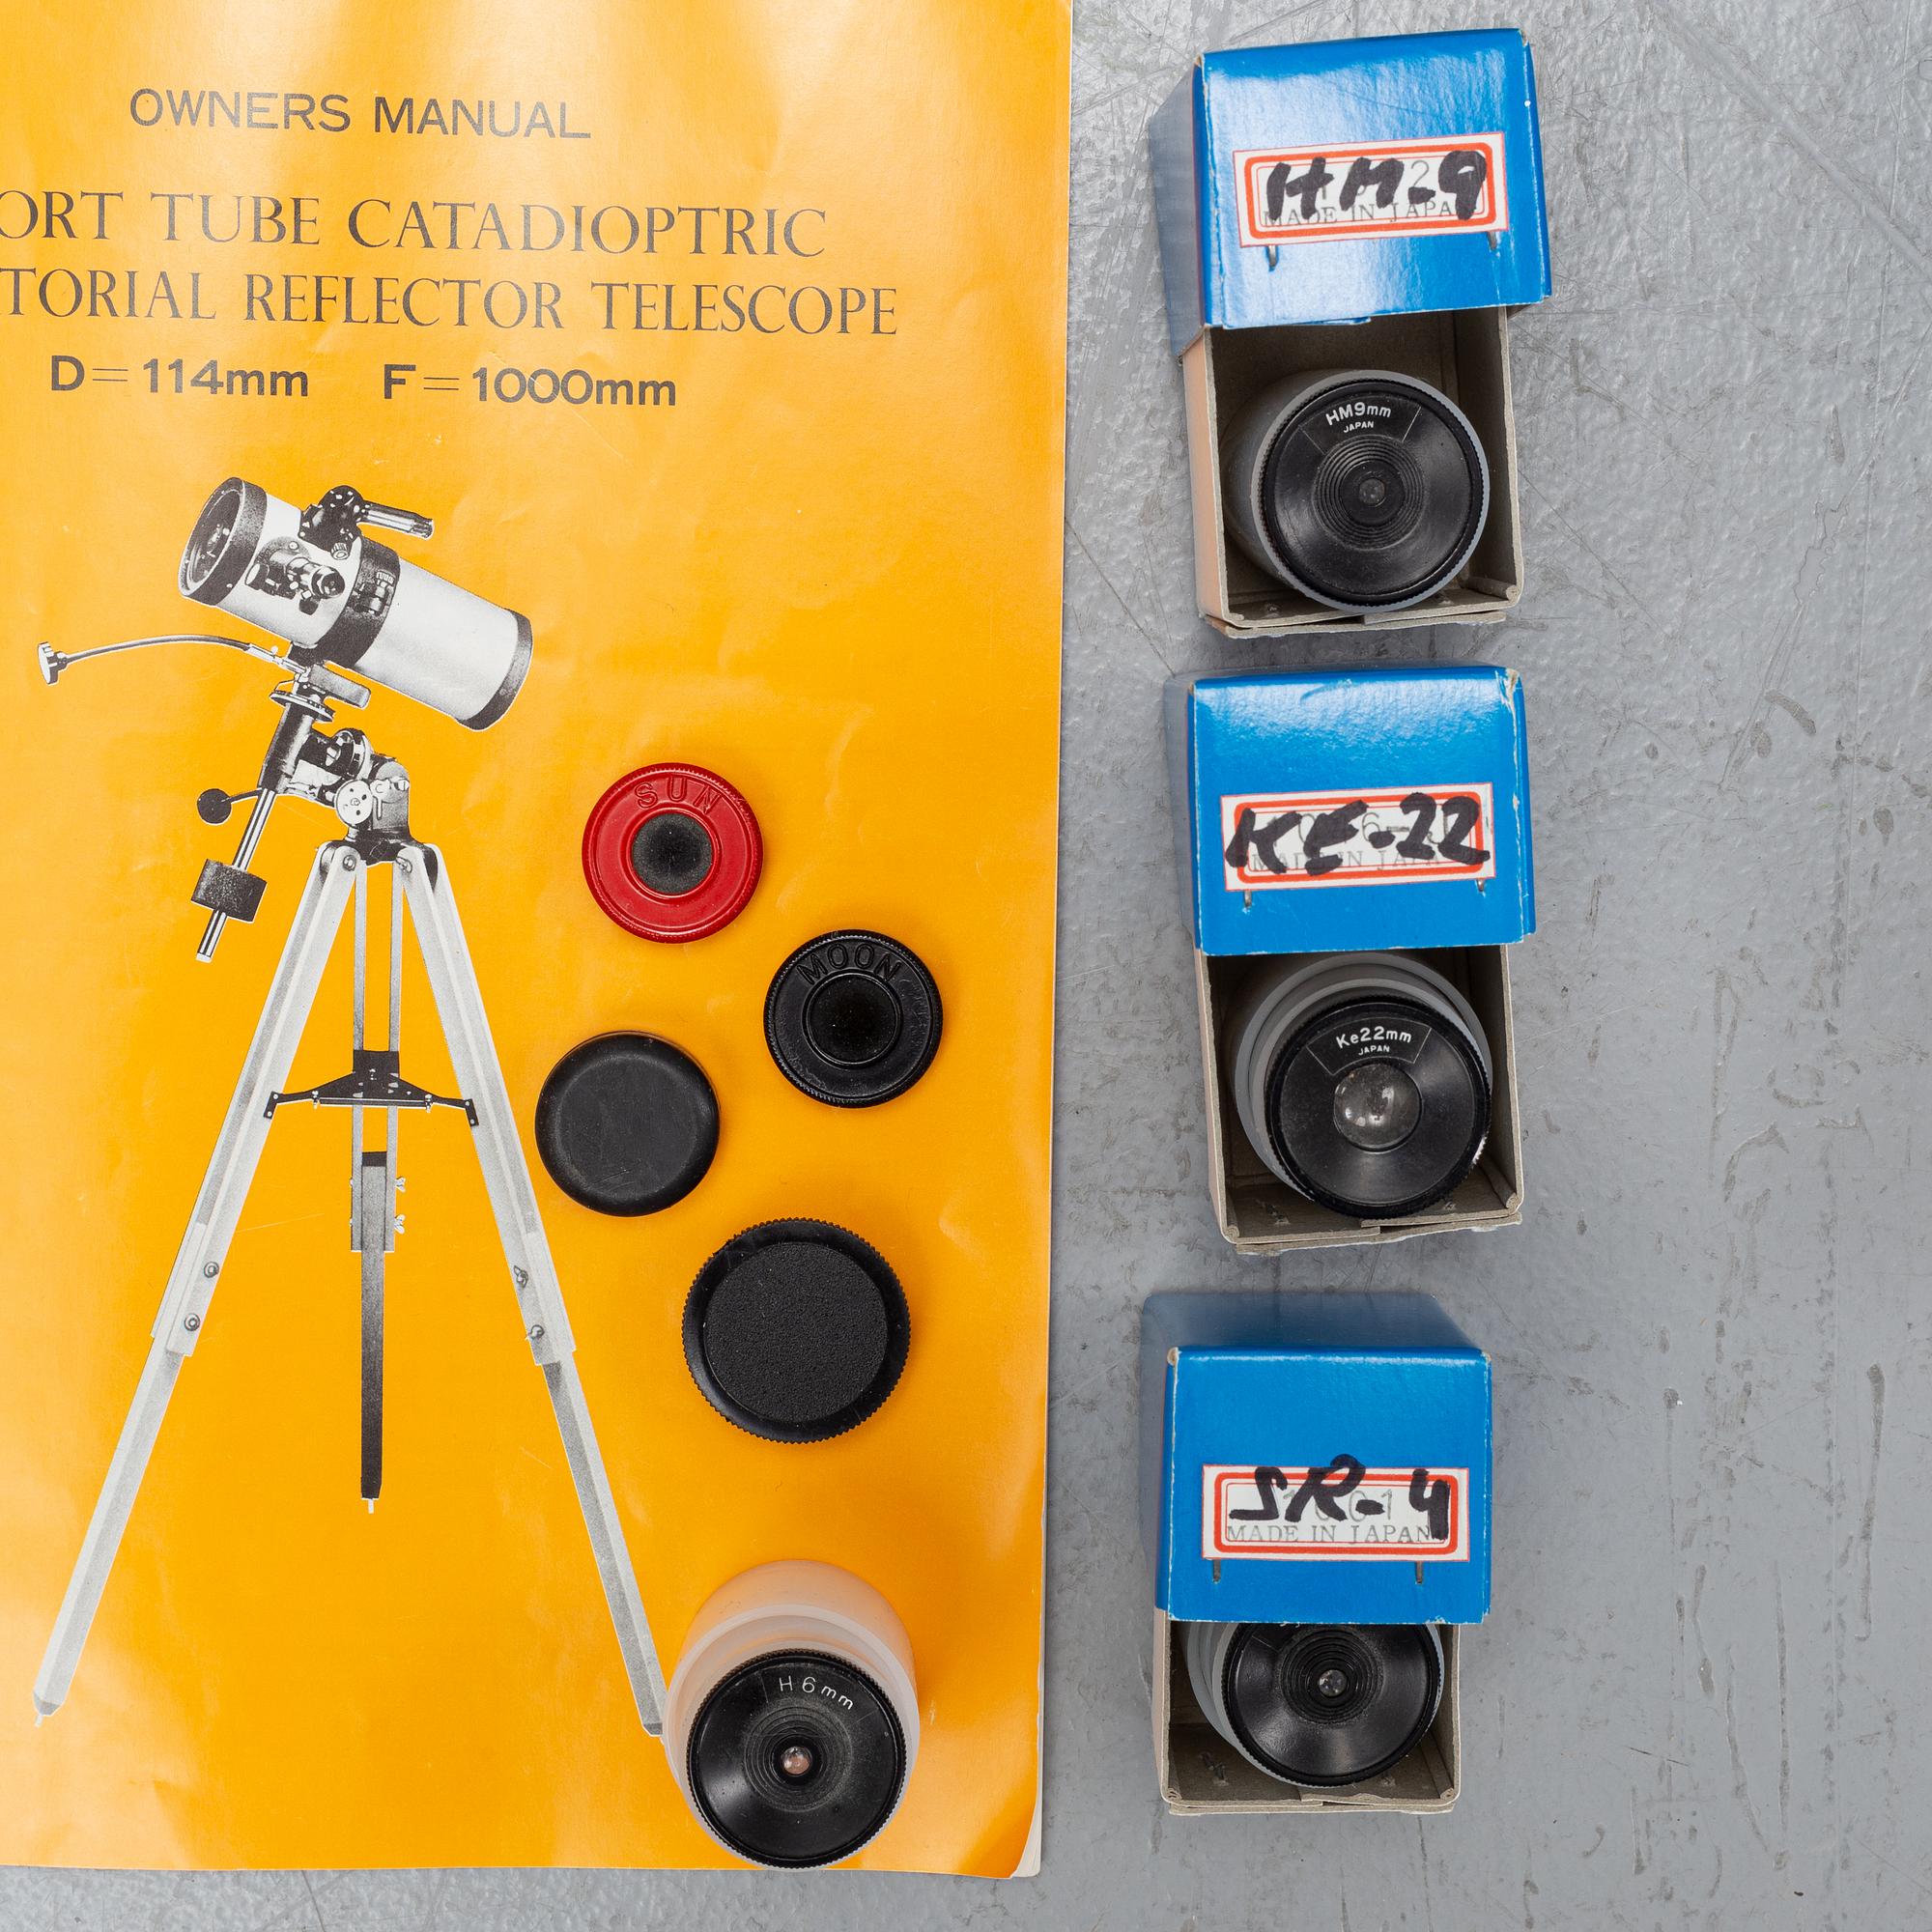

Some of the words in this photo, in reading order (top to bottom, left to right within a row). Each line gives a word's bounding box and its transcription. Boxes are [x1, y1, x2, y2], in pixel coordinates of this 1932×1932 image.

[130, 88, 351, 131] OWNERS
[375, 97, 591, 139] MANUAL
[0, 190, 124, 240] ORT
[151, 192, 321, 244] TUBE
[348, 199, 826, 257] CATADIOPTRIC
[1352, 203, 1376, 221] IN
[1390, 201, 1456, 222] JAPA
[0, 268, 216, 320] TORIAL
[244, 273, 564, 329] REFLECTOR
[591, 280, 897, 335] TELESCOPE
[1325, 402, 1391, 426] HM9mm
[1343, 421, 1375, 434] JAPAN
[634, 777, 724, 814] SUN
[796, 943, 904, 985] MOON
[1336, 1026, 1412, 1049] Ke22mm
[1358, 1045, 1390, 1056] JAPAN
[1227, 1524, 1299, 1543] MADE
[1312, 1525, 1337, 1543] IN
